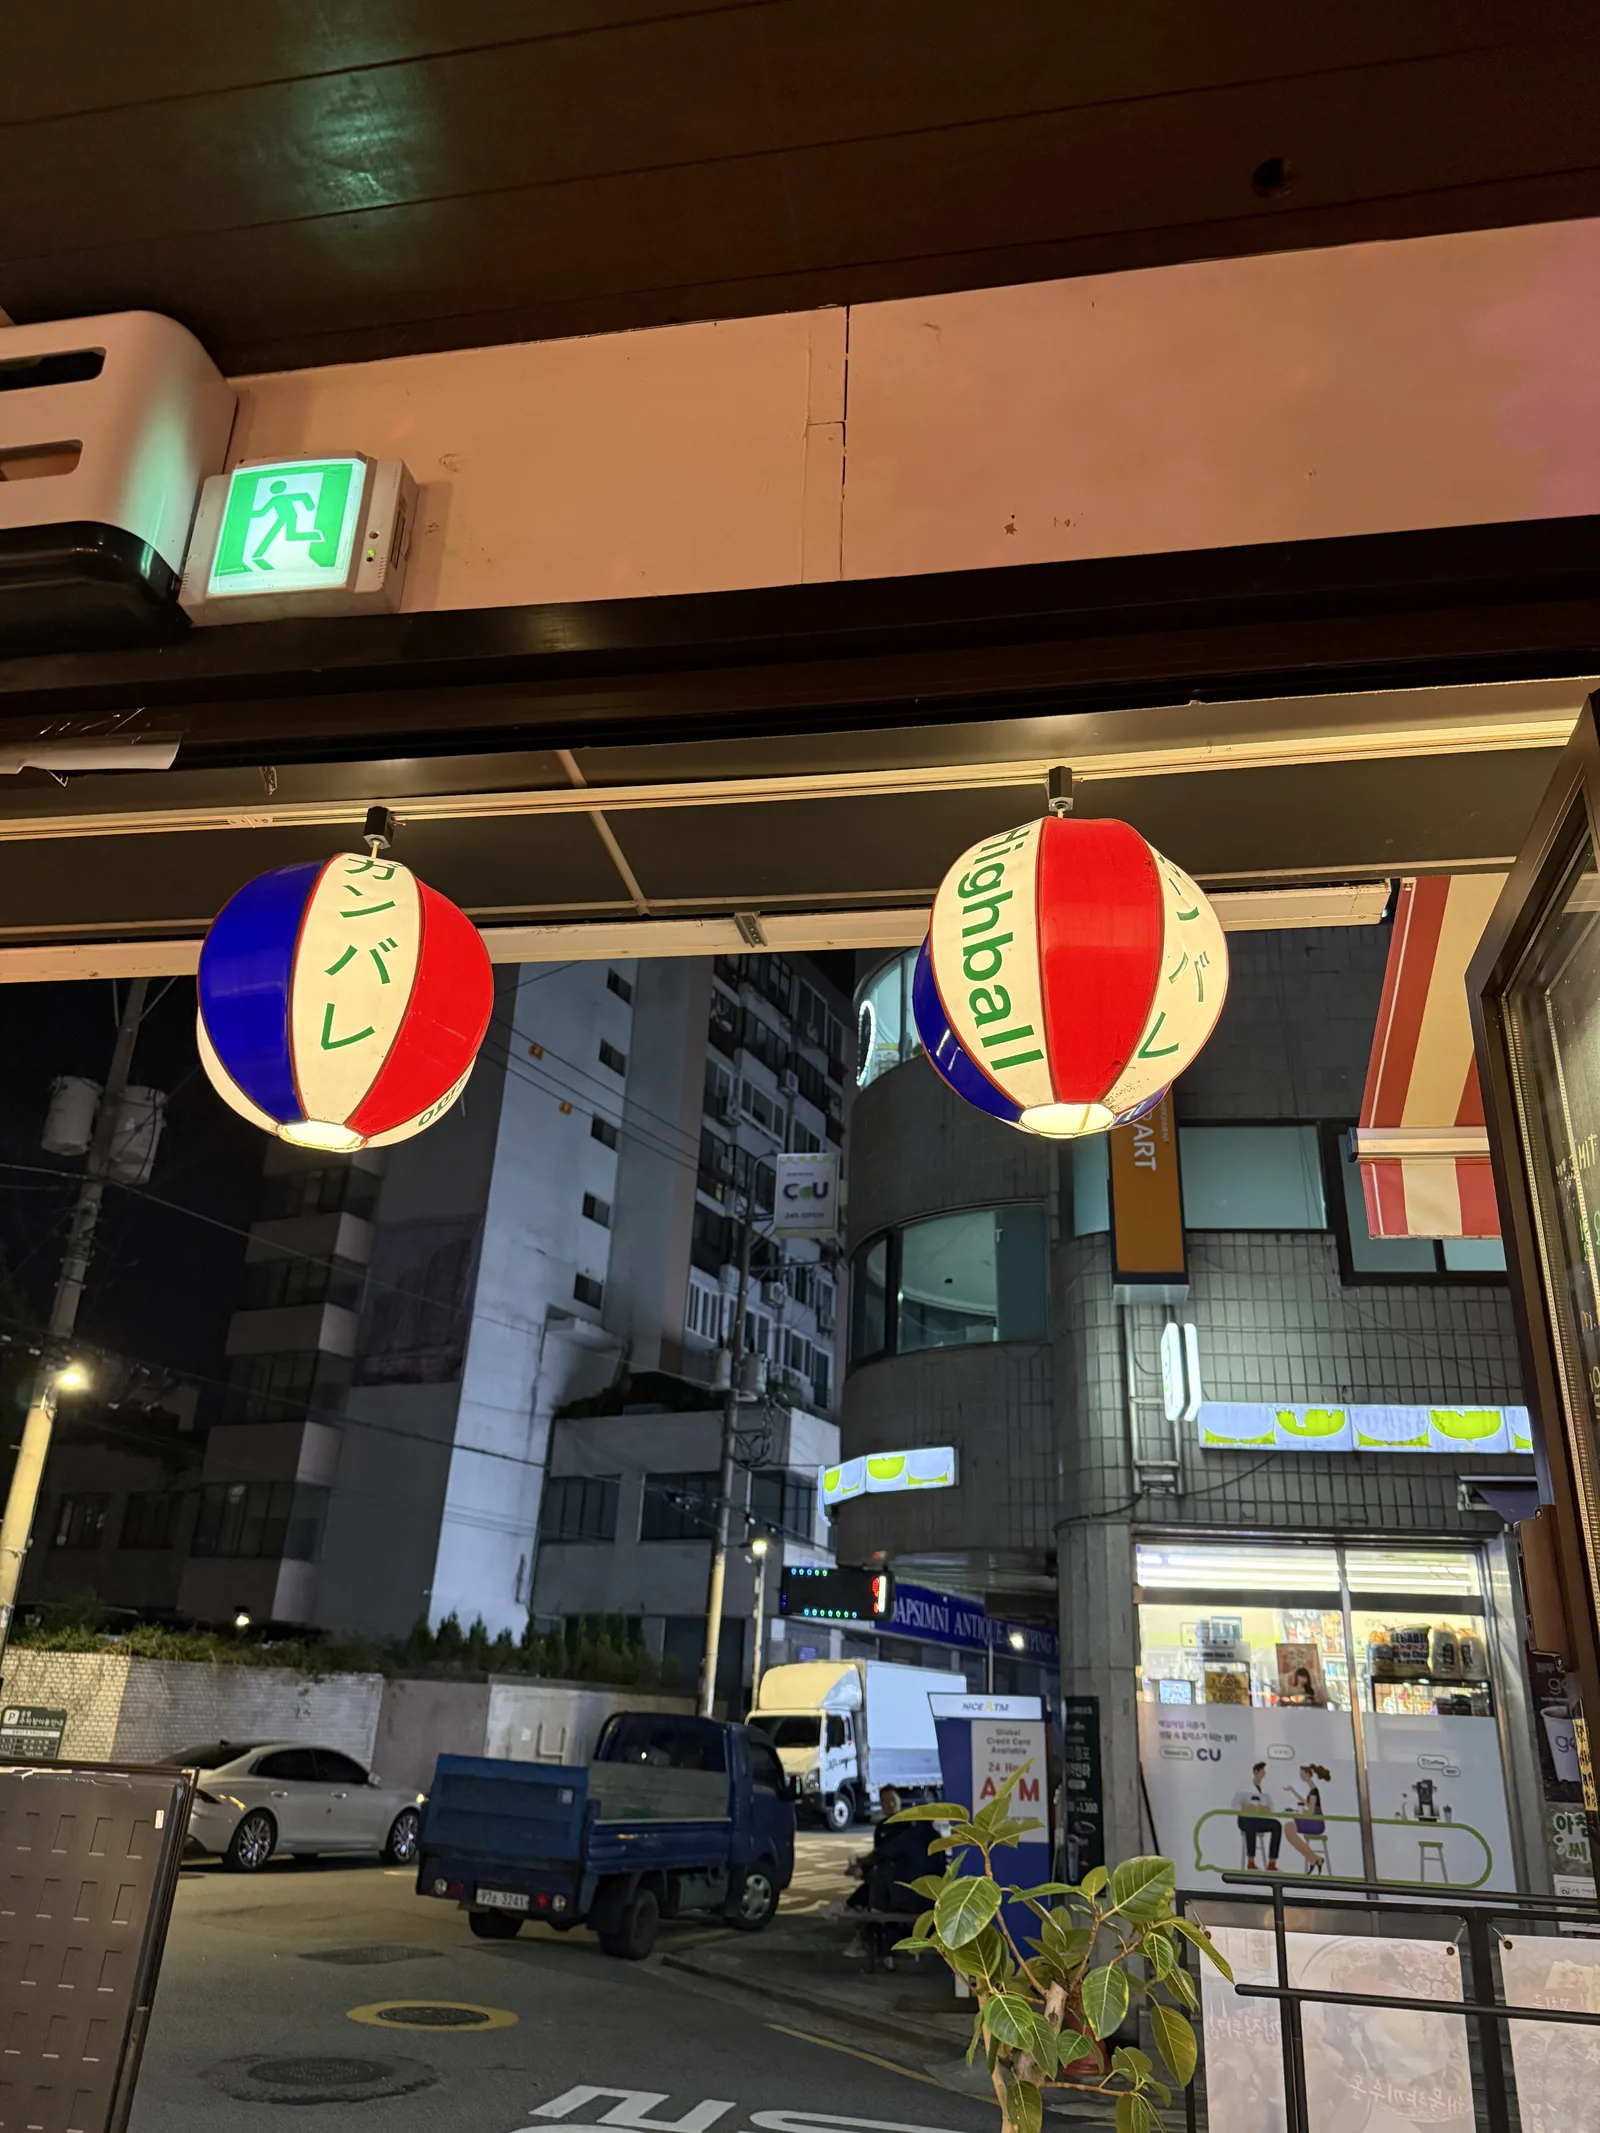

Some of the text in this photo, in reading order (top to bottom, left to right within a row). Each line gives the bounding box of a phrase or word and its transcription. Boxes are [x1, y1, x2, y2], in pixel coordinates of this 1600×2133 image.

[321, 858, 404, 1051] ガンバレ
[783, 1181, 828, 1201] CU
[953, 1611, 1003, 1646] ANTIQUE
[986, 1737, 1031, 1747] Credit Card
[1197, 1748, 1221, 1761] CU
[988, 1761, 1000, 1772] 24
